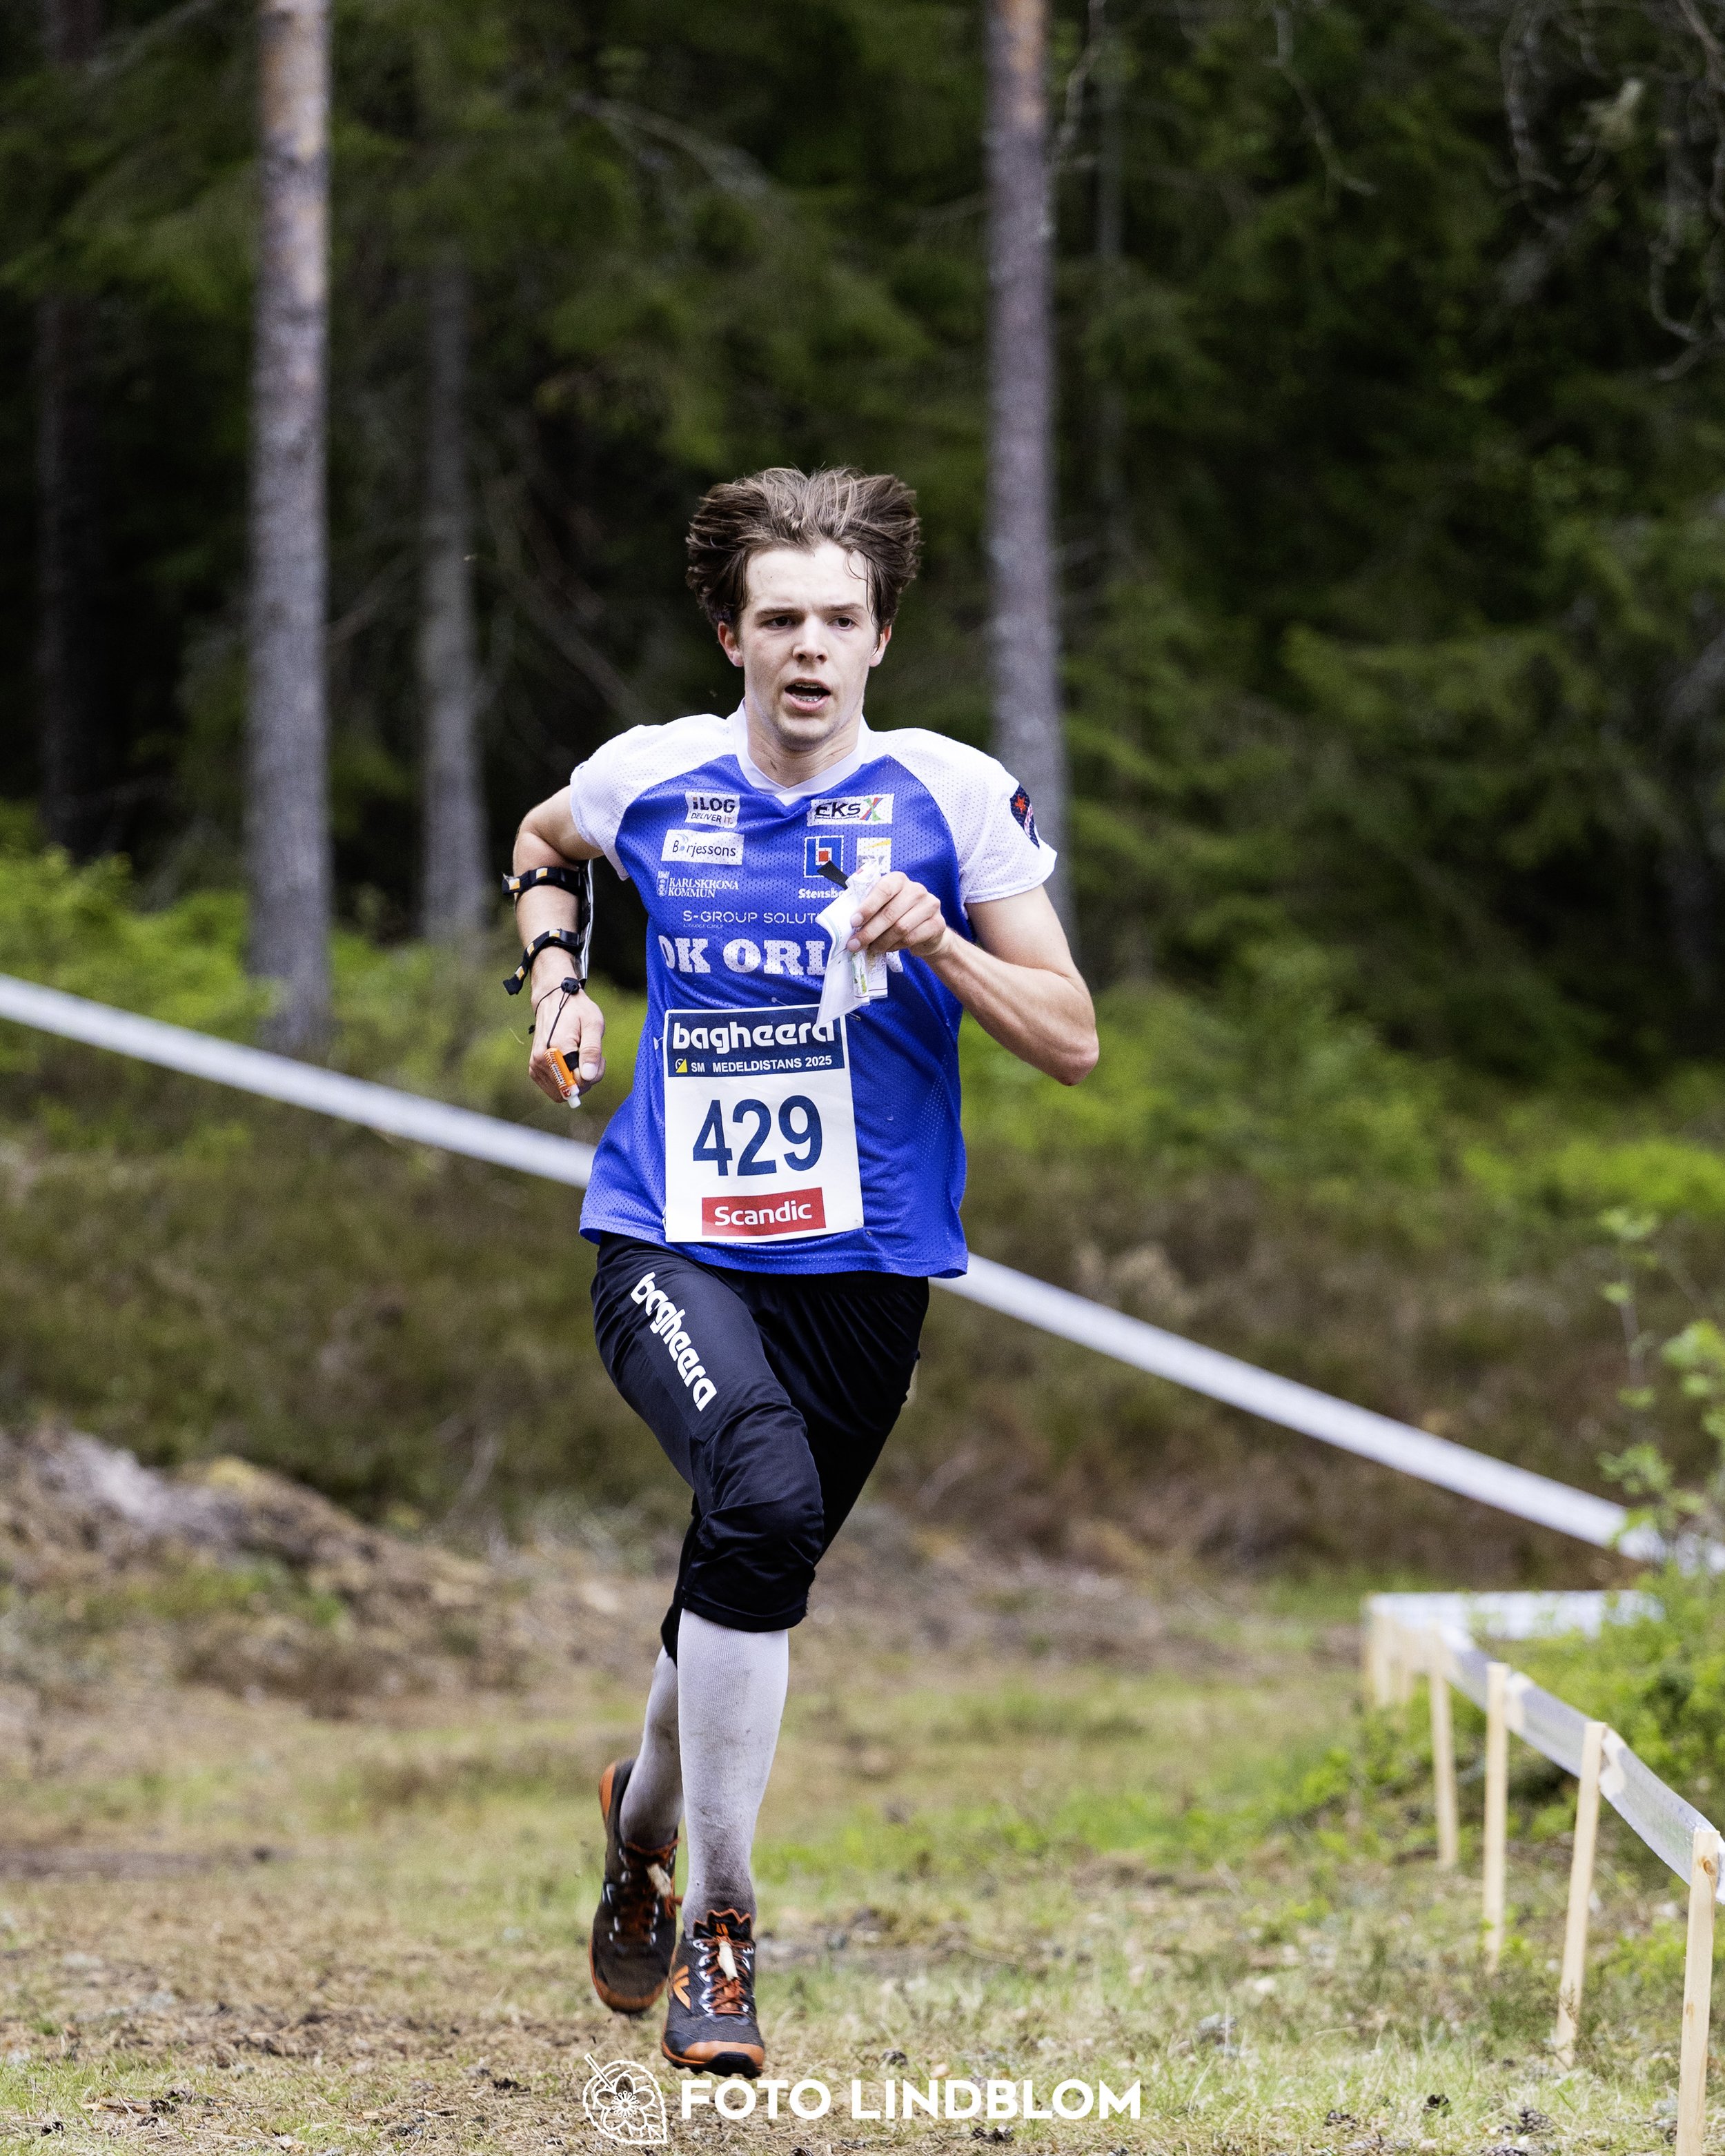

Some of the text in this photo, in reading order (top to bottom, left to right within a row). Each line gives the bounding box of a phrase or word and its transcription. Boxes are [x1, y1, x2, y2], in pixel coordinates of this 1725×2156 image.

[692, 796, 736, 813] iLOG
[691, 813, 722, 824] DELIVER
[668, 887, 716, 898] KOMMUN
[669, 878, 740, 890] KARLSKRONA
[683, 910, 820, 924] S-GROUP SOLUT
[673, 1020, 835, 1054] bagheera
[691, 1055, 833, 1074] SM MEDELDISTANS 2025
[692, 1095, 823, 1176] 429
[713, 1200, 813, 1227] Scandic
[630, 1272, 718, 1412] bagheera
